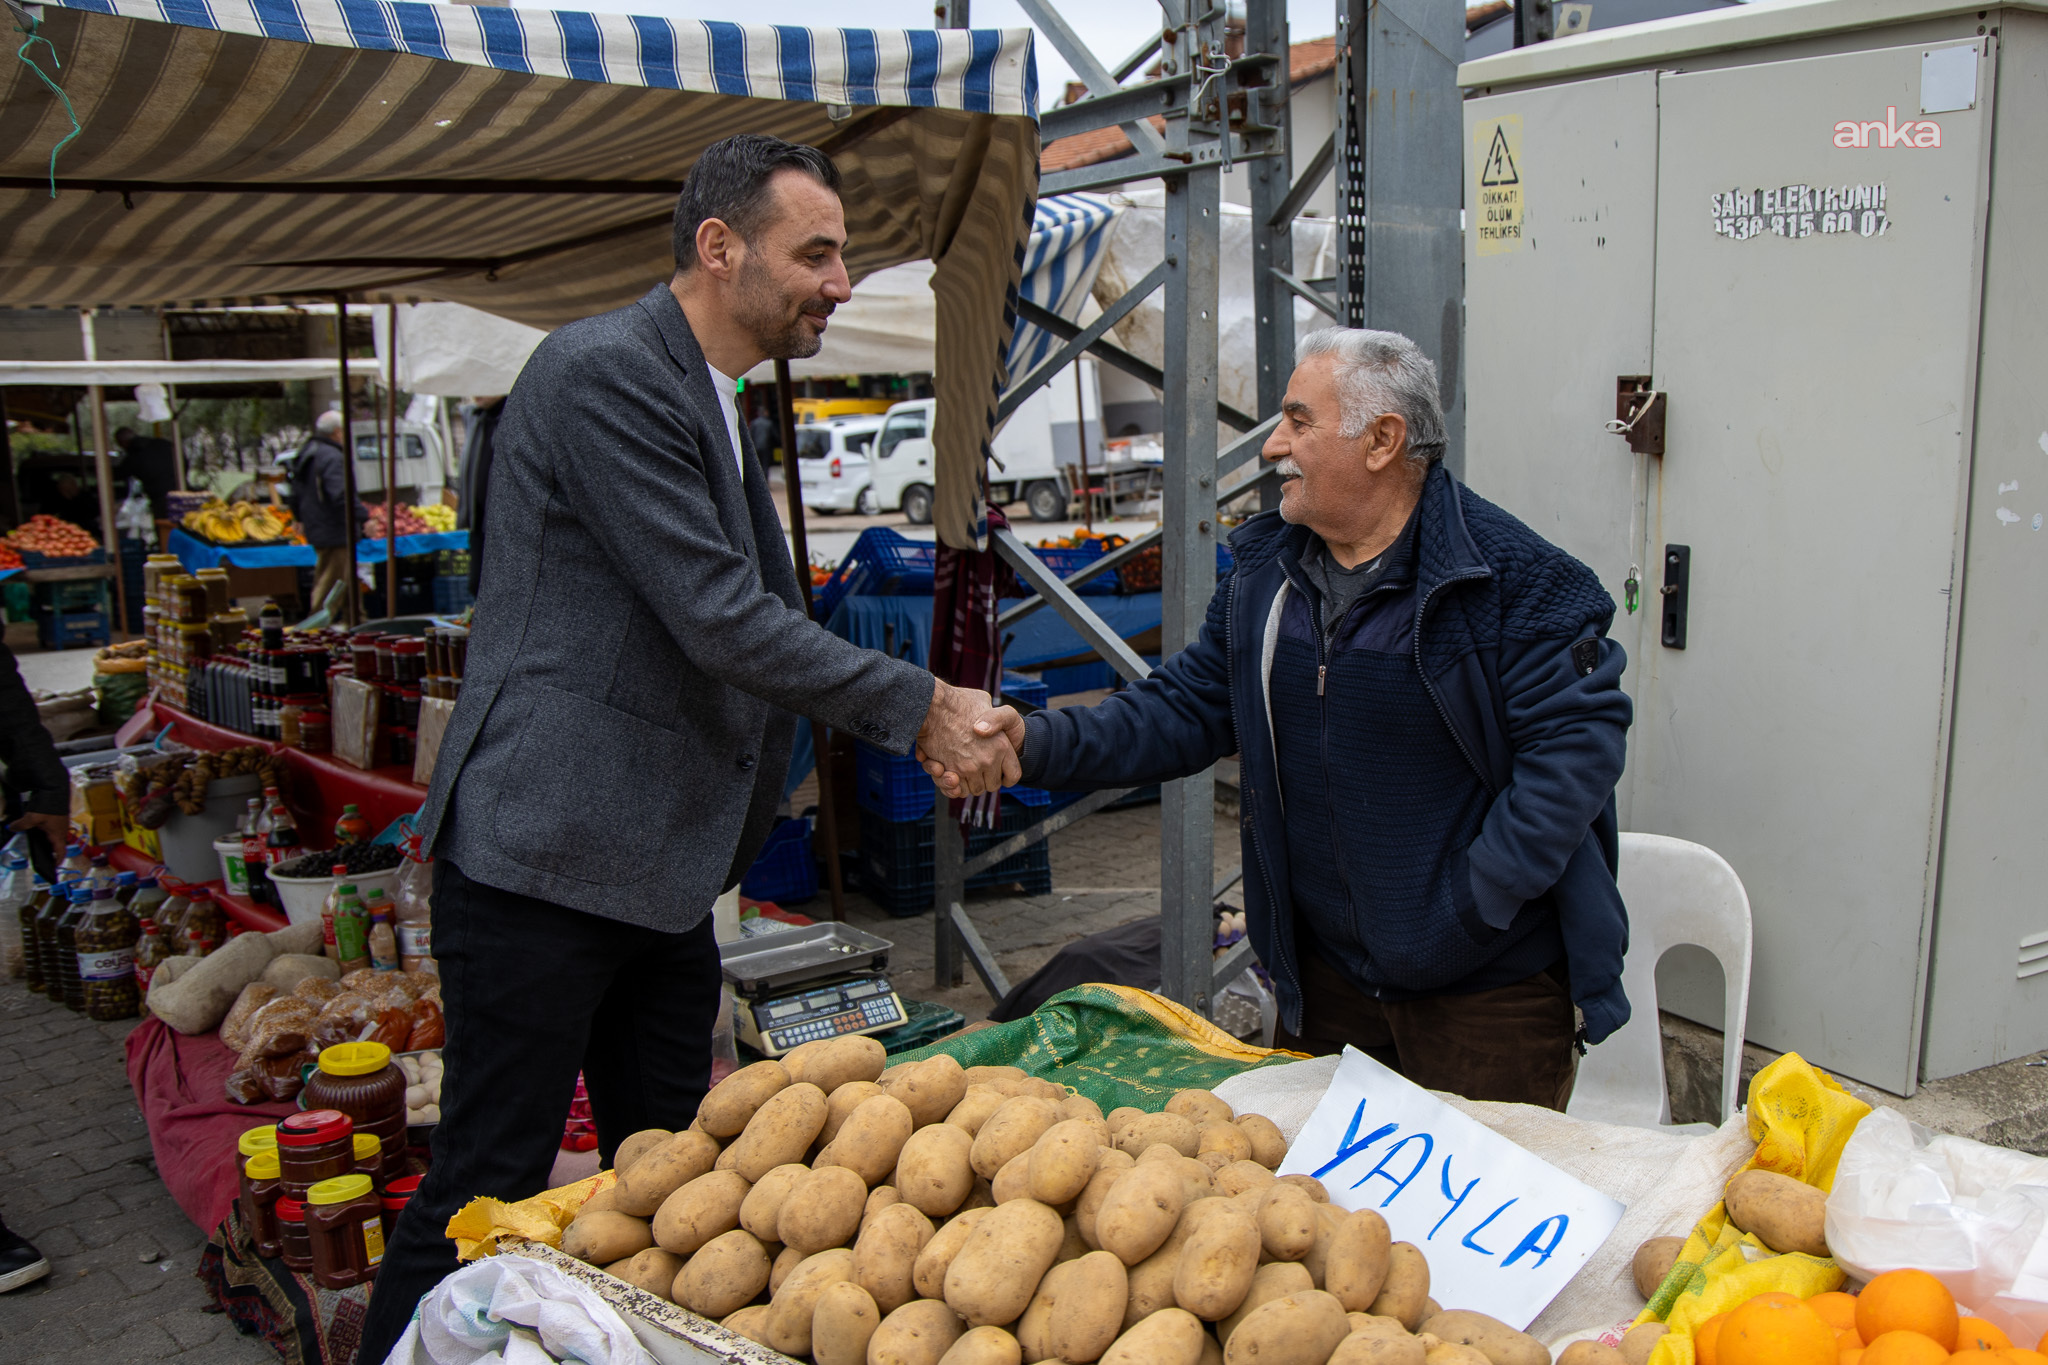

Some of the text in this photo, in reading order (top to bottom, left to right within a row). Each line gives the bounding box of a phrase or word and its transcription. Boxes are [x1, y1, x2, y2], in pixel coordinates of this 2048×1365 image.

[1483, 189, 1517, 205] DİKKAT!
[1487, 206, 1513, 221] ÖLÜM
[1861, 210, 1889, 237] 07
[1310, 1098, 1570, 1269] YAYLA
